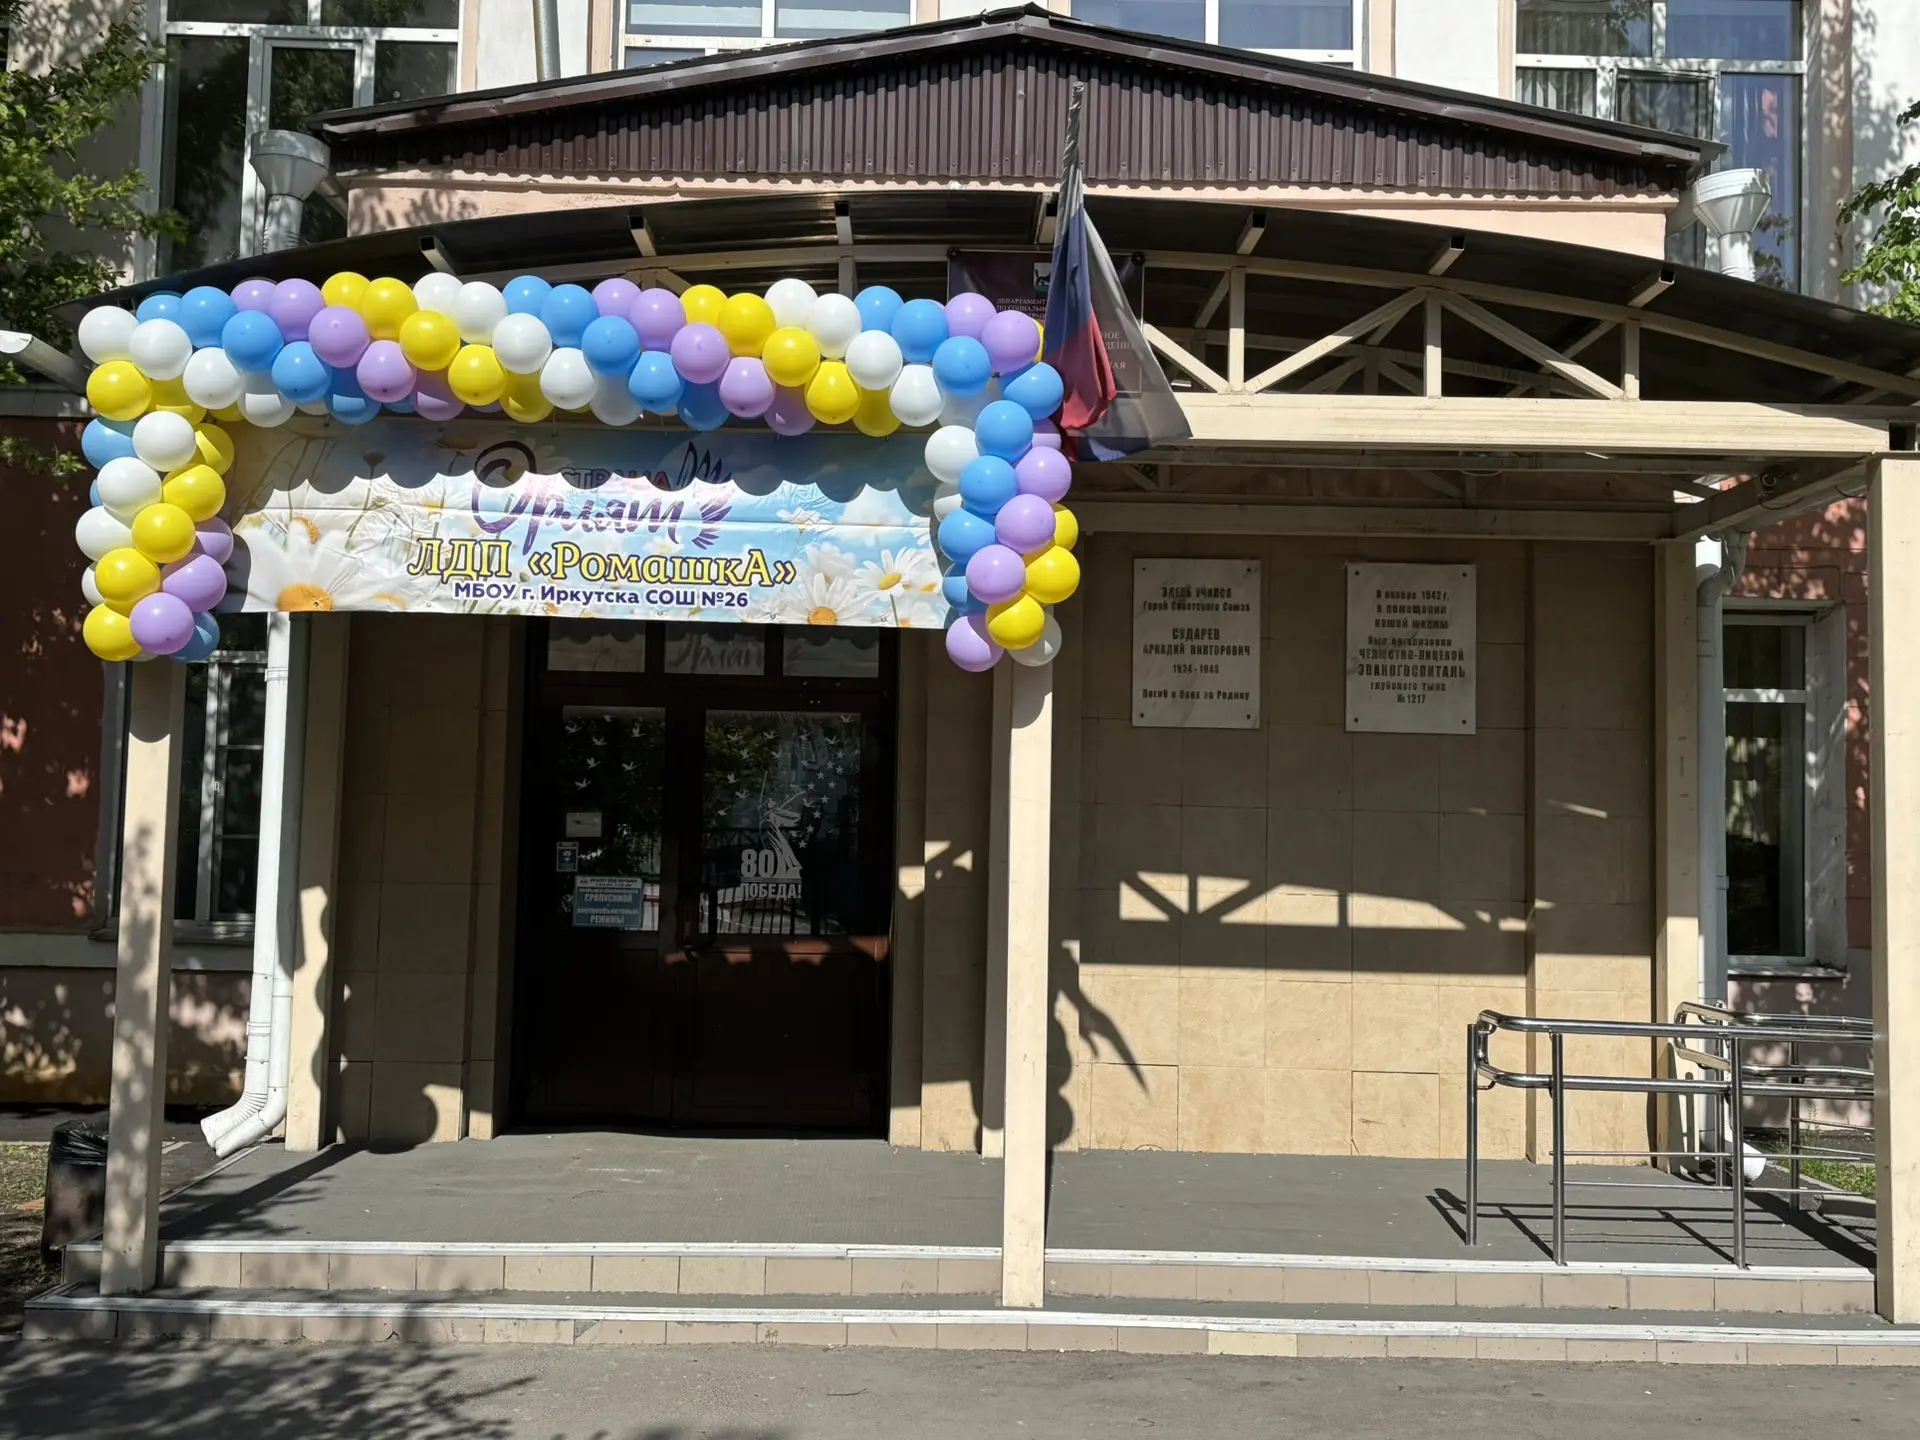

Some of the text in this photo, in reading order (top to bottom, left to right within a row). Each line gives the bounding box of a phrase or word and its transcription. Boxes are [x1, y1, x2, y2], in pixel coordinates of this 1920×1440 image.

[407, 538, 512, 584] ЛДП
[454, 582, 749, 608] МБОУ г. Иркутска СОШ №26
[1196, 587, 1232, 598] УЧИЛСЯ
[1143, 600, 1250, 612] Герой Советского Союза
[1172, 627, 1220, 642] СУДАРЕВ
[1143, 642, 1250, 657] АРКАДИЙ ВИКТОРОВИЧ
[1142, 688, 1168, 698] Погиб
[1217, 690, 1250, 701] Родину
[740, 848, 775, 878] 80
[740, 883, 802, 900] ПОБЕДА!
